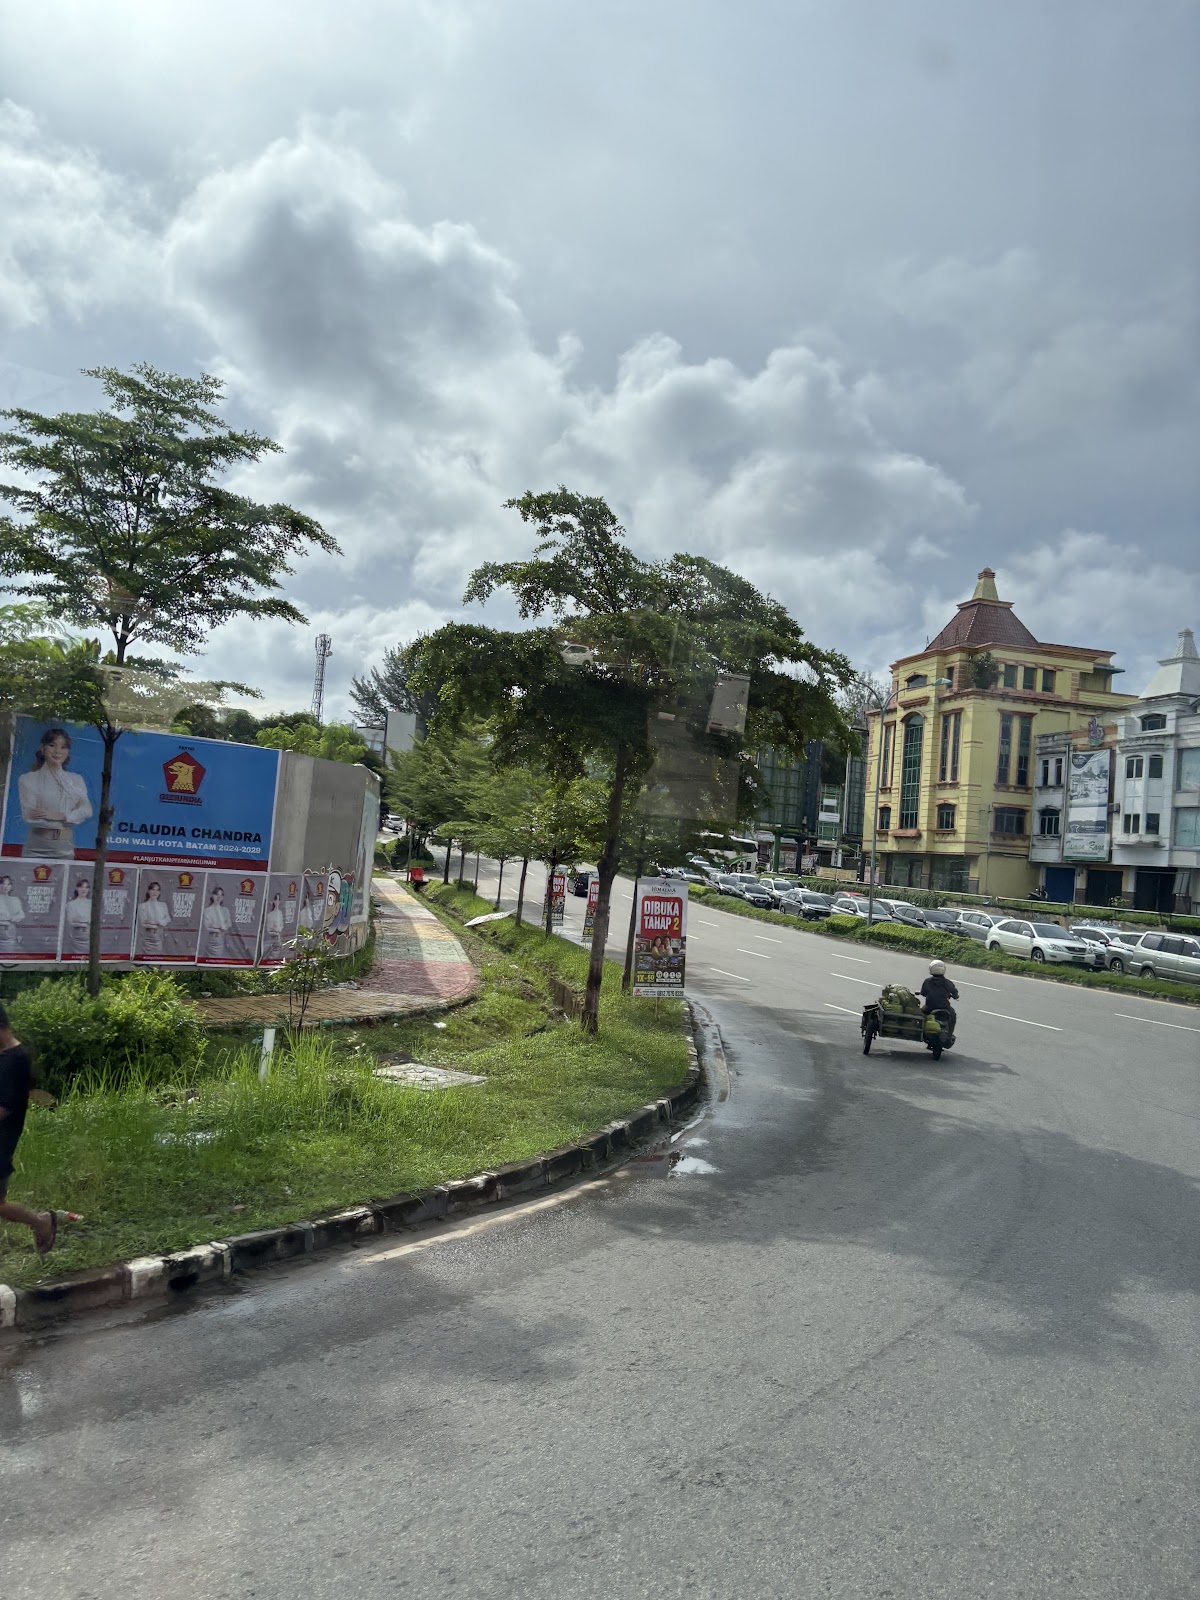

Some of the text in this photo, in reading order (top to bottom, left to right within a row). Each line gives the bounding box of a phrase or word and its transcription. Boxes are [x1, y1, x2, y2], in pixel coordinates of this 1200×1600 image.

[117, 821, 262, 843] CLAUDIA CHANDRA
[132, 837, 156, 847] WALI
[157, 840, 184, 849] KOTA
[185, 842, 217, 851] BATAM
[218, 844, 262, 854] 2024-2029
[643, 900, 680, 916] DIBUKA
[643, 915, 680, 931] TAHAP 2
